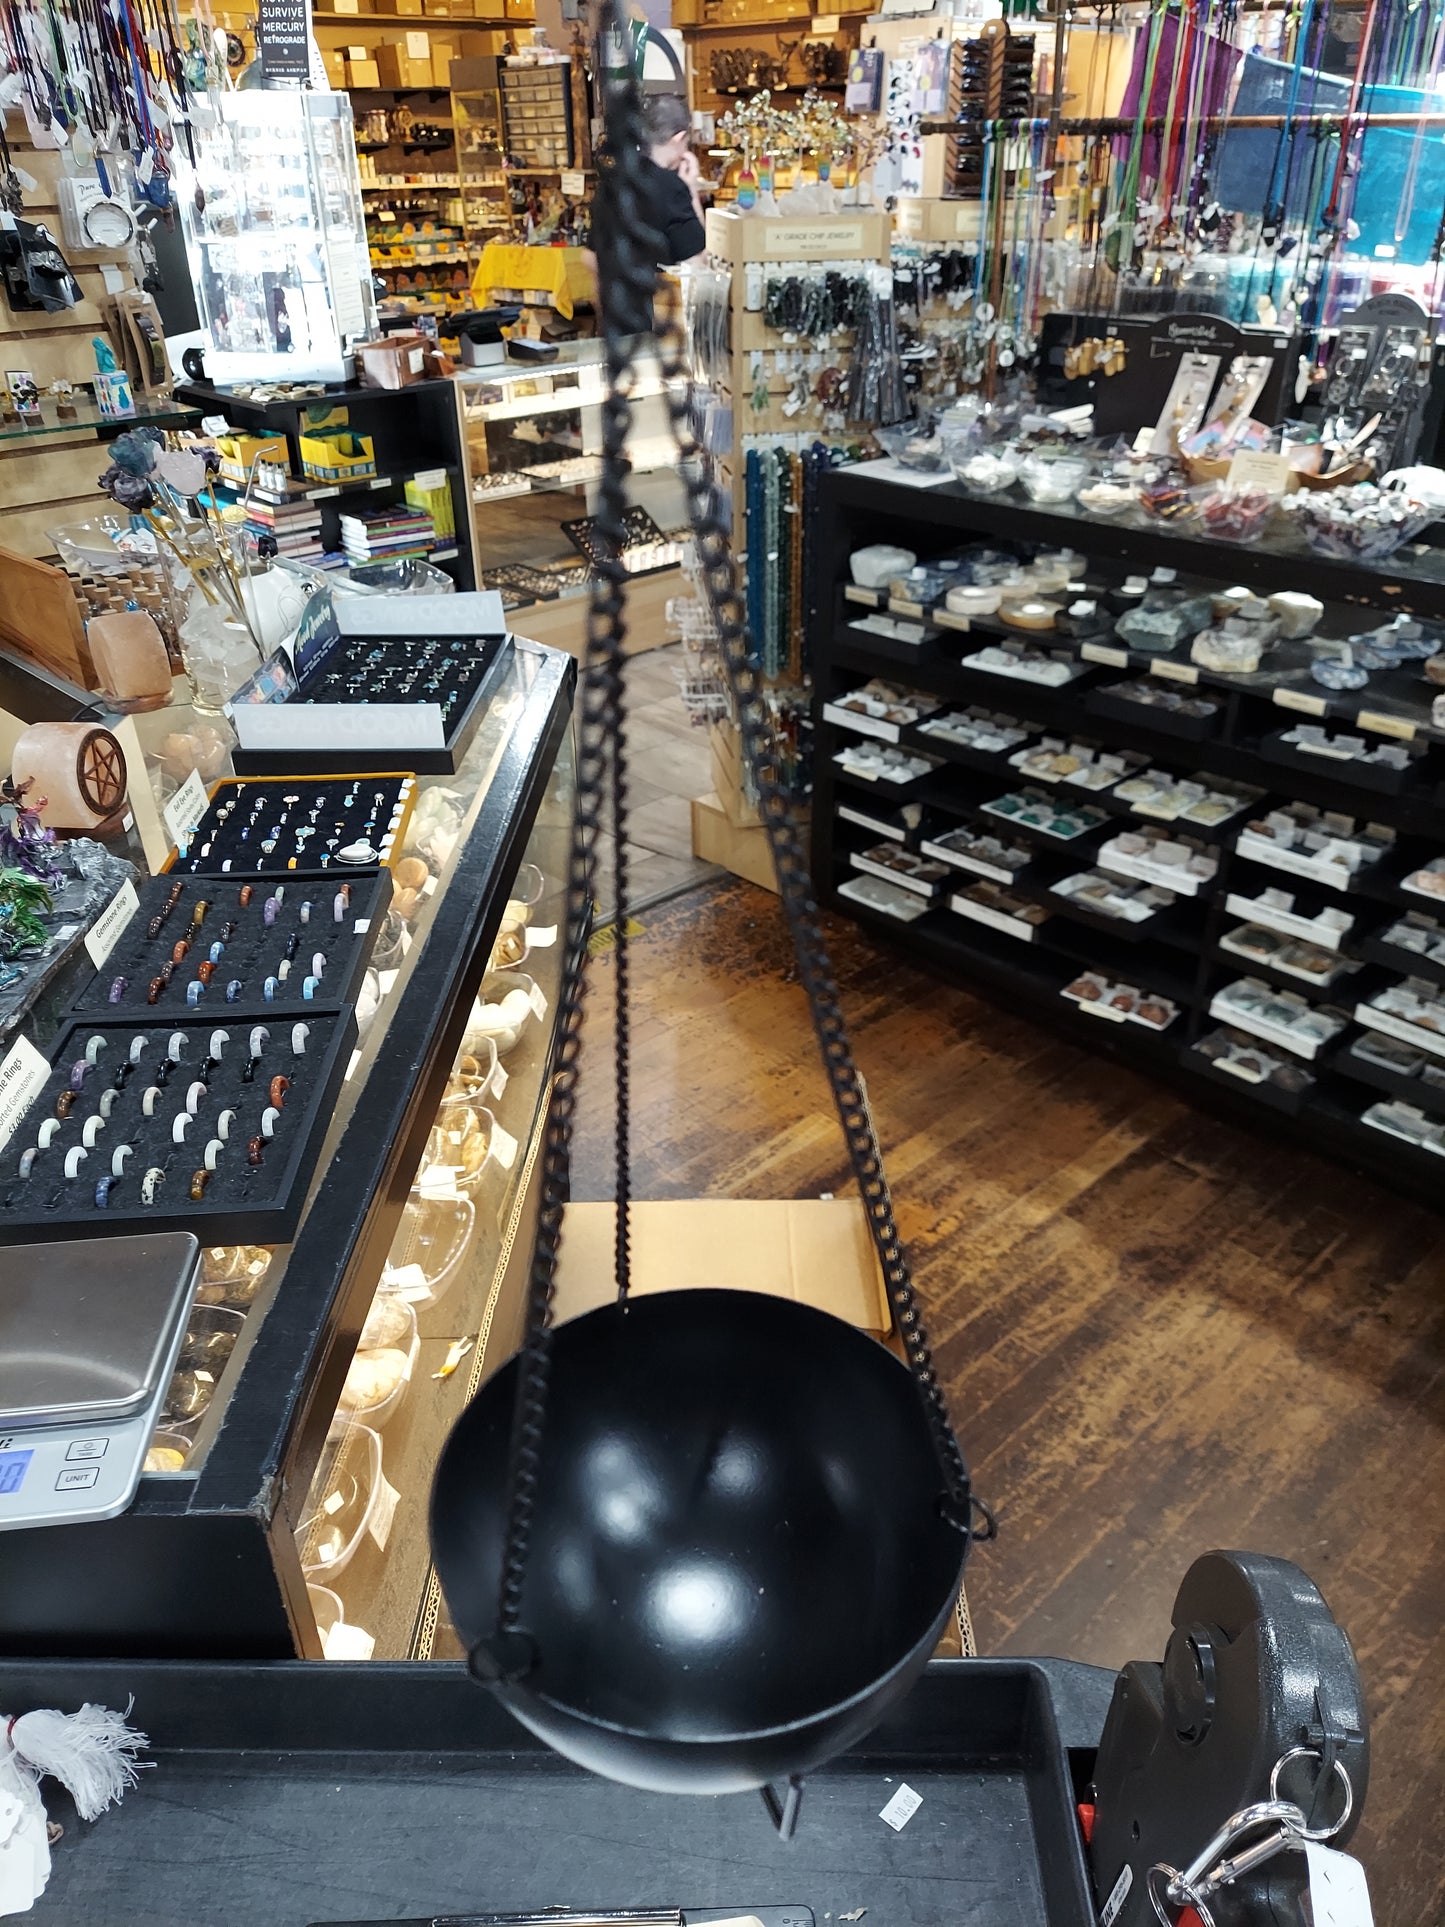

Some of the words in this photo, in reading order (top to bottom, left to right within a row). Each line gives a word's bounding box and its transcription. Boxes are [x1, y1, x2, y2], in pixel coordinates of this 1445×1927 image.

[262, 6, 304, 18] SURVIVE
[262, 21, 305, 32] MERCURY
[263, 34, 306, 44] RETROGRADE
[96, 909, 118, 939] Gemstone
[3, 1057, 22, 1081] Rings
[9, 1070, 35, 1106] Gemstones
[65, 1474, 90, 1483] UNIT
